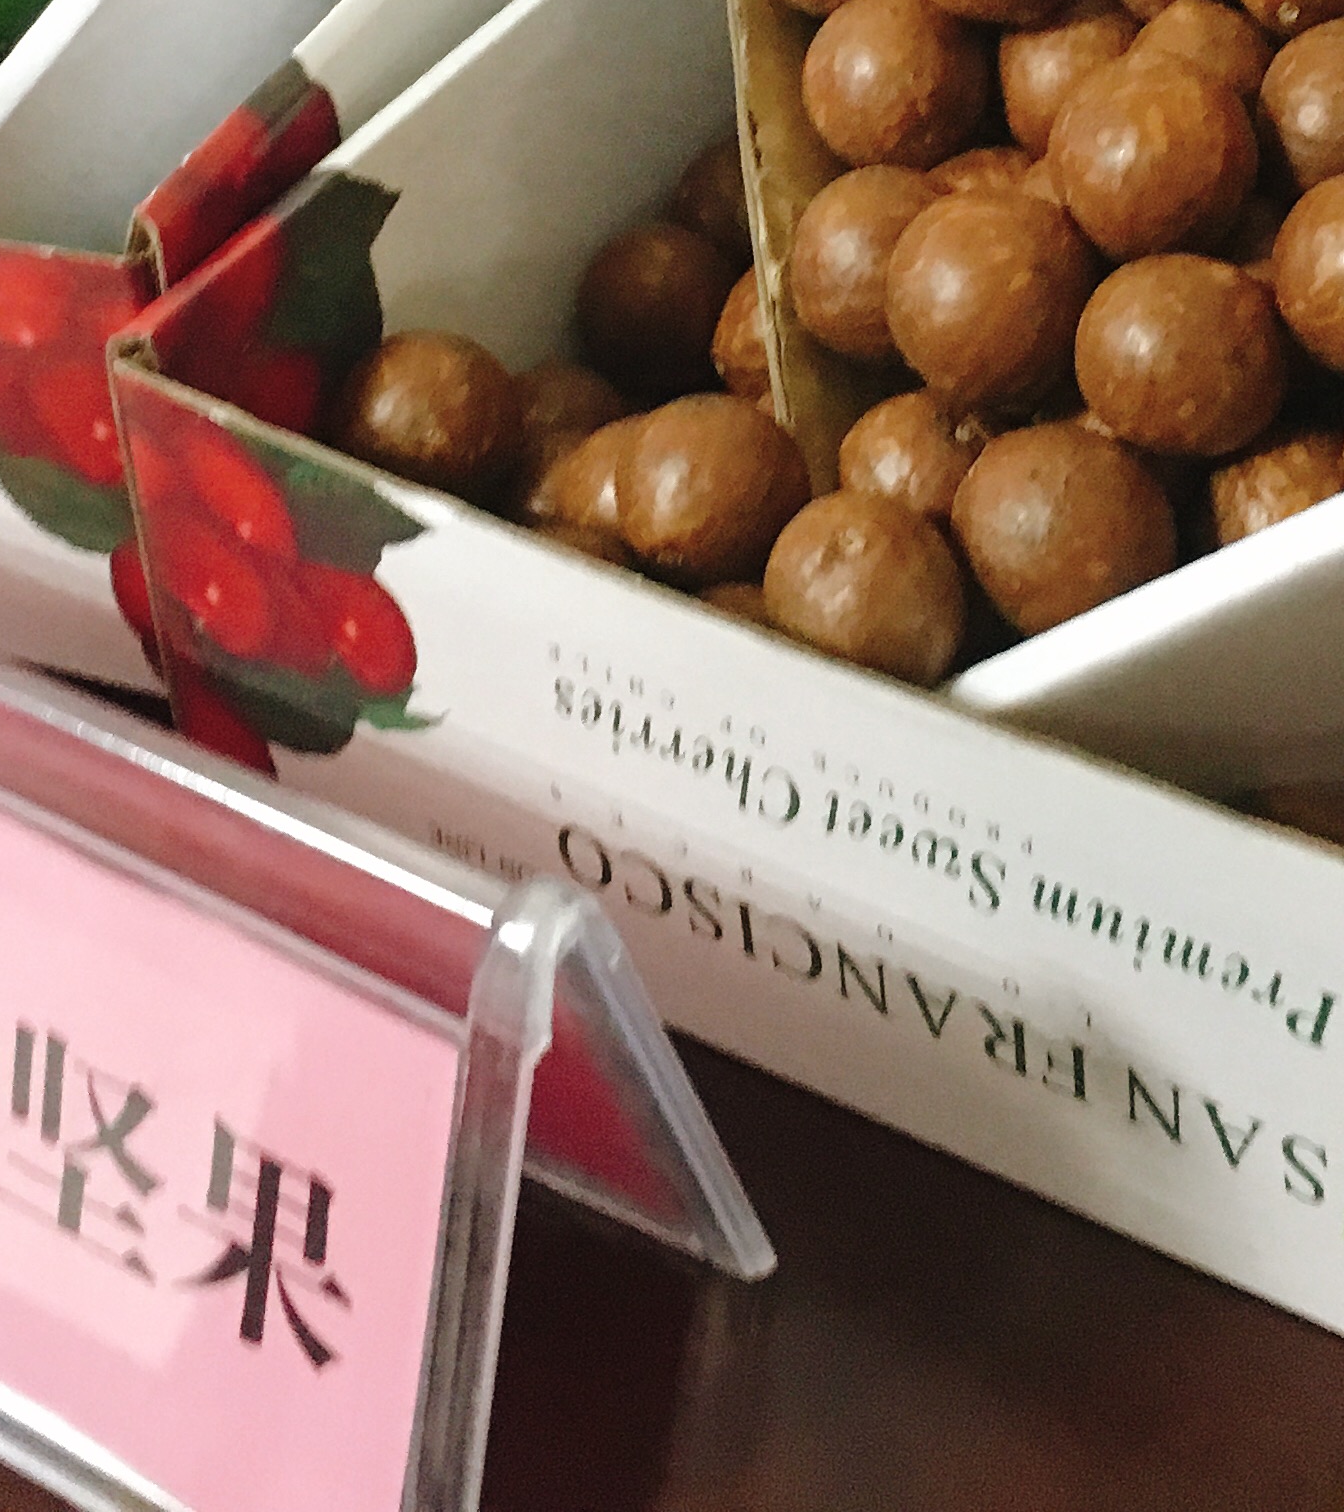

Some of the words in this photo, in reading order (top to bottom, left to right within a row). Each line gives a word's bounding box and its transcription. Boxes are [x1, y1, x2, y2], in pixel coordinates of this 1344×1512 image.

[554, 675, 801, 827] Cherries
[824, 789, 1007, 912] Sweet
[558, 823, 1088, 1102] FRANCISCO
[1030, 872, 1336, 1049] Premium
[1127, 1064, 1329, 1206] SAN
